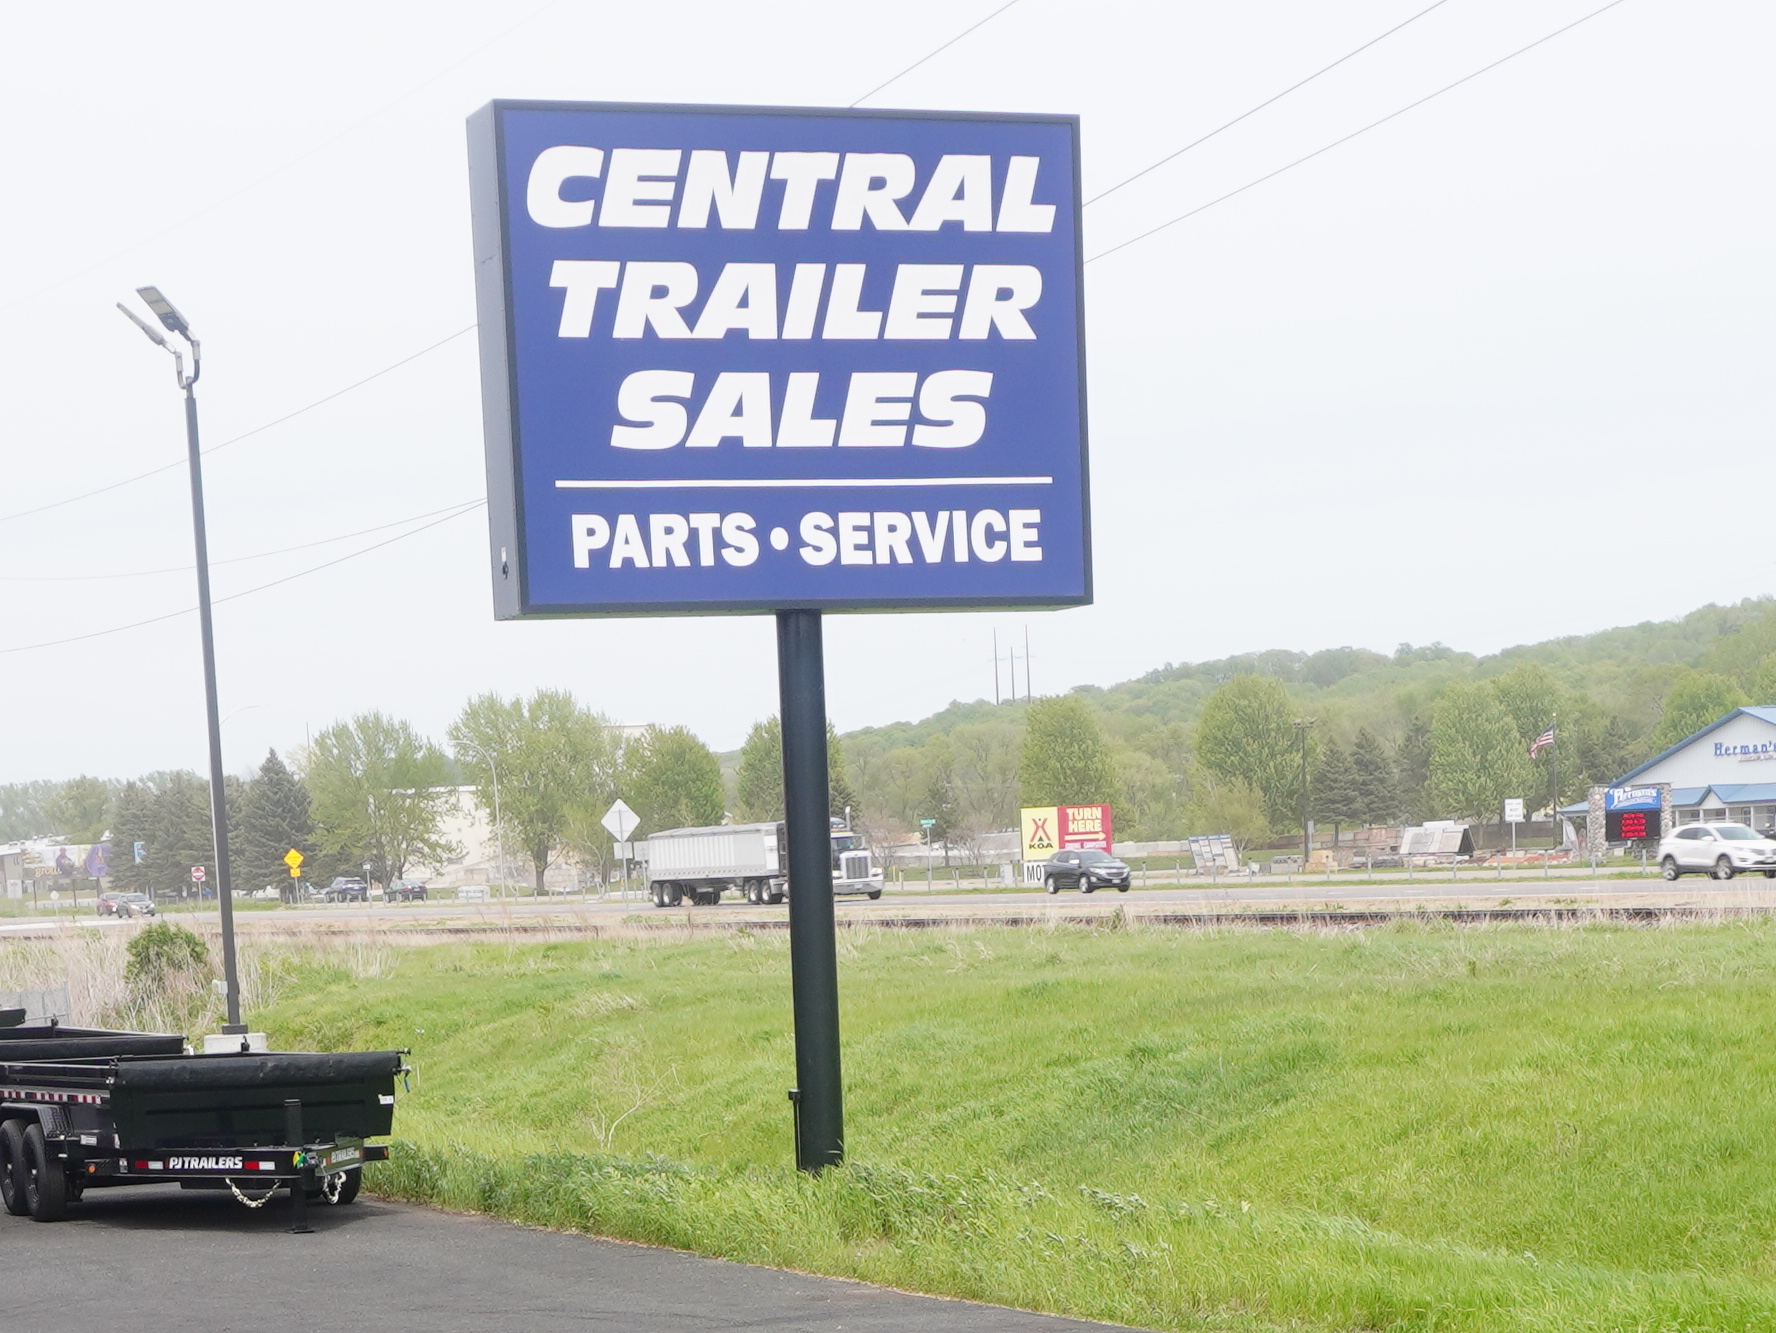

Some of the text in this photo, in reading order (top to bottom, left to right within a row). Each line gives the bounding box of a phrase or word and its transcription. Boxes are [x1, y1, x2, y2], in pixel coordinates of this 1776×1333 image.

[526, 145, 1057, 233] CENTRAL
[549, 260, 1043, 340] TRAILER
[610, 369, 994, 450] SALES
[571, 509, 1043, 569] PARTS SERVICE
[1066, 807, 1102, 820] TURN
[1068, 820, 1102, 833] HERE
